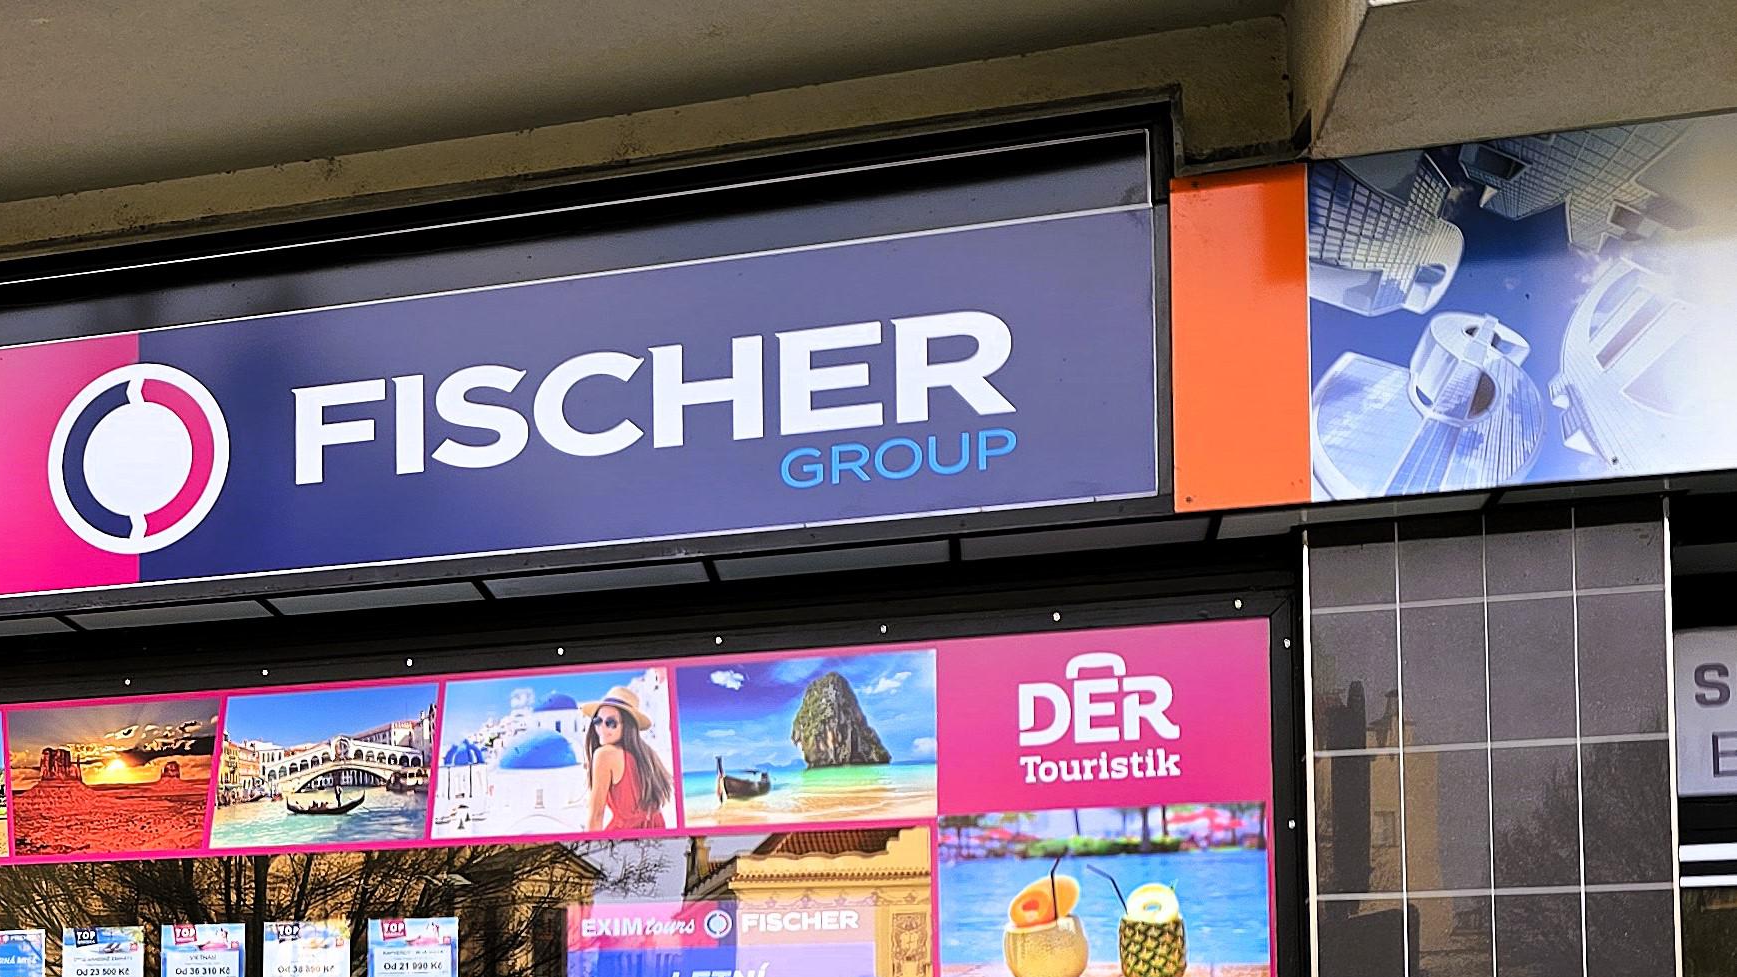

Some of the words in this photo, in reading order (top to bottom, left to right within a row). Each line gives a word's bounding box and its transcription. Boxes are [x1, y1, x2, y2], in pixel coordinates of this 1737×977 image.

[292, 310, 1017, 486] FISCHER
[780, 427, 1018, 489] GROUP
[1018, 675, 1181, 747] DER
[1019, 748, 1181, 784] Touristik
[742, 910, 860, 933] FISCHER
[175, 926, 196, 938] TOP
[278, 924, 299, 937] TOP
[383, 922, 405, 934] TOP
[76, 931, 96, 941] TOP
[76, 968, 88, 976] Od
[90, 968, 100, 976] 23
[119, 967, 130, 976] Kč
[175, 967, 188, 975] Od
[202, 967, 217, 975] 310
[219, 966, 231, 975] Kč
[277, 965, 291, 974] Od
[383, 962, 397, 970] Od
[399, 962, 409, 970] 21
[430, 961, 443, 970] Kč
